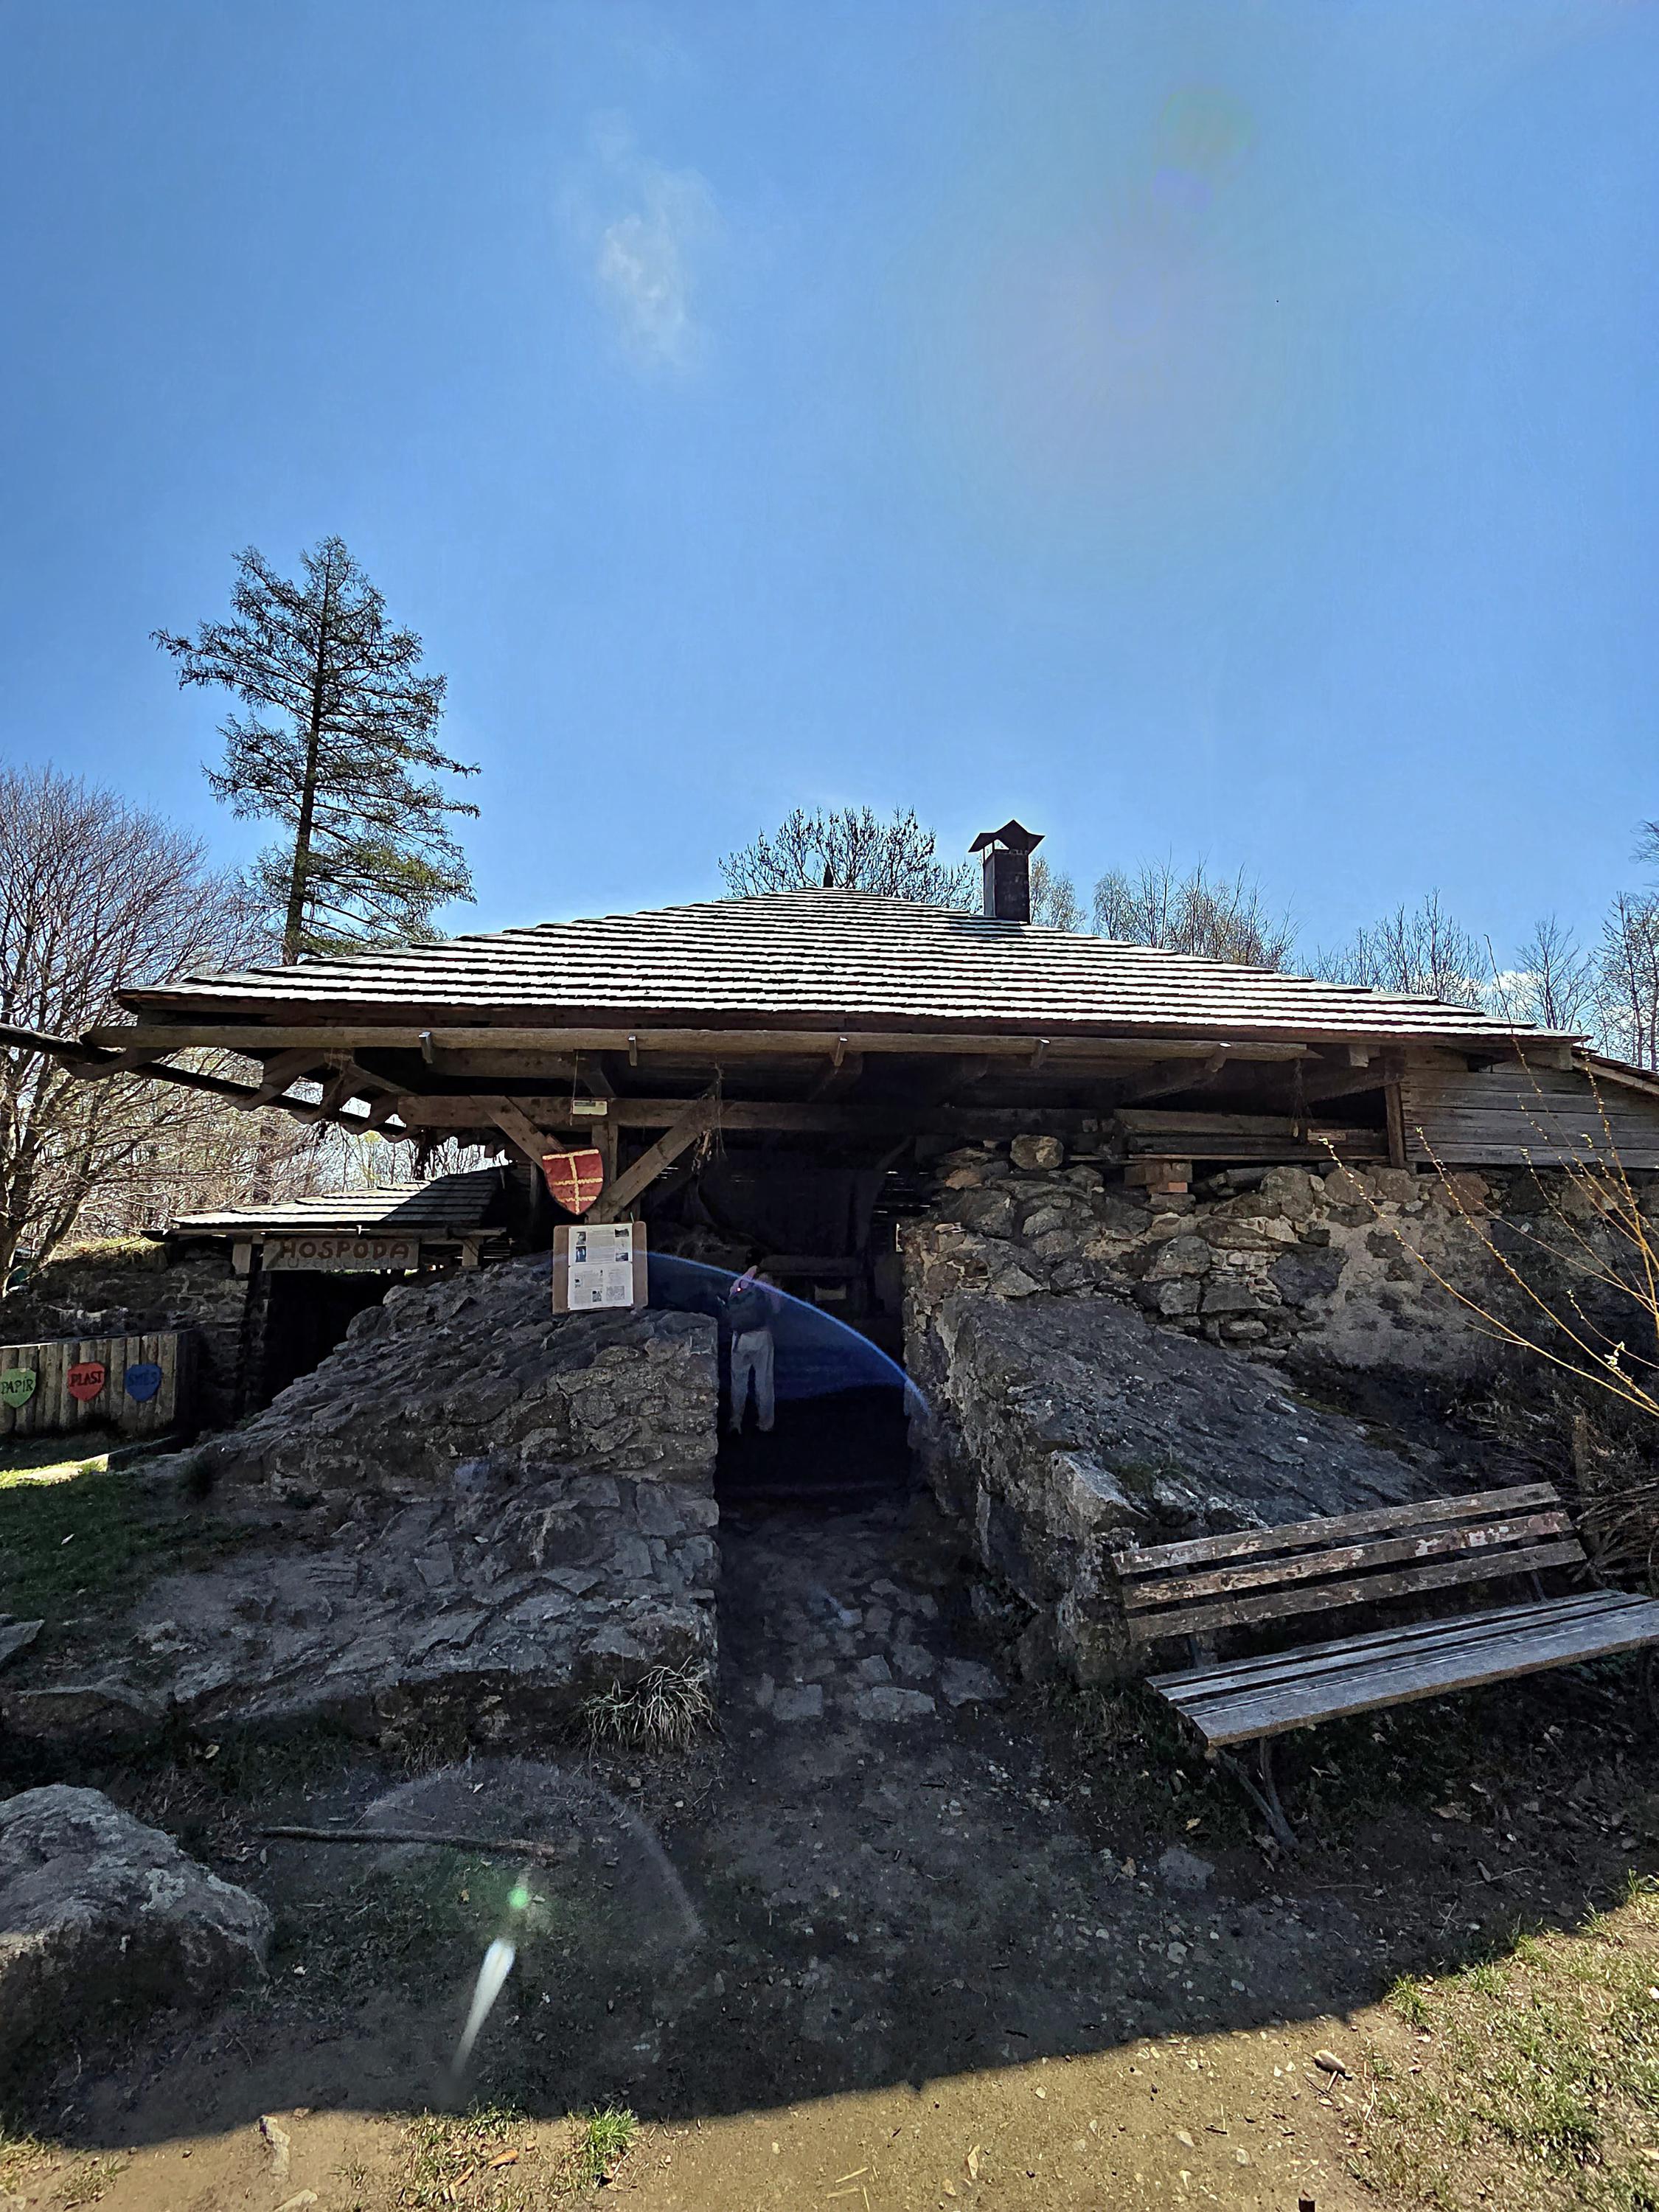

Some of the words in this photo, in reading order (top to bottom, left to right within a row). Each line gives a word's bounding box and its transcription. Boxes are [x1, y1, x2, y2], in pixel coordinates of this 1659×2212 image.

[281, 1240, 410, 1260] HOSPODA
[1, 1376, 34, 1394] PAPÍR
[69, 1371, 104, 1388] PLAST
